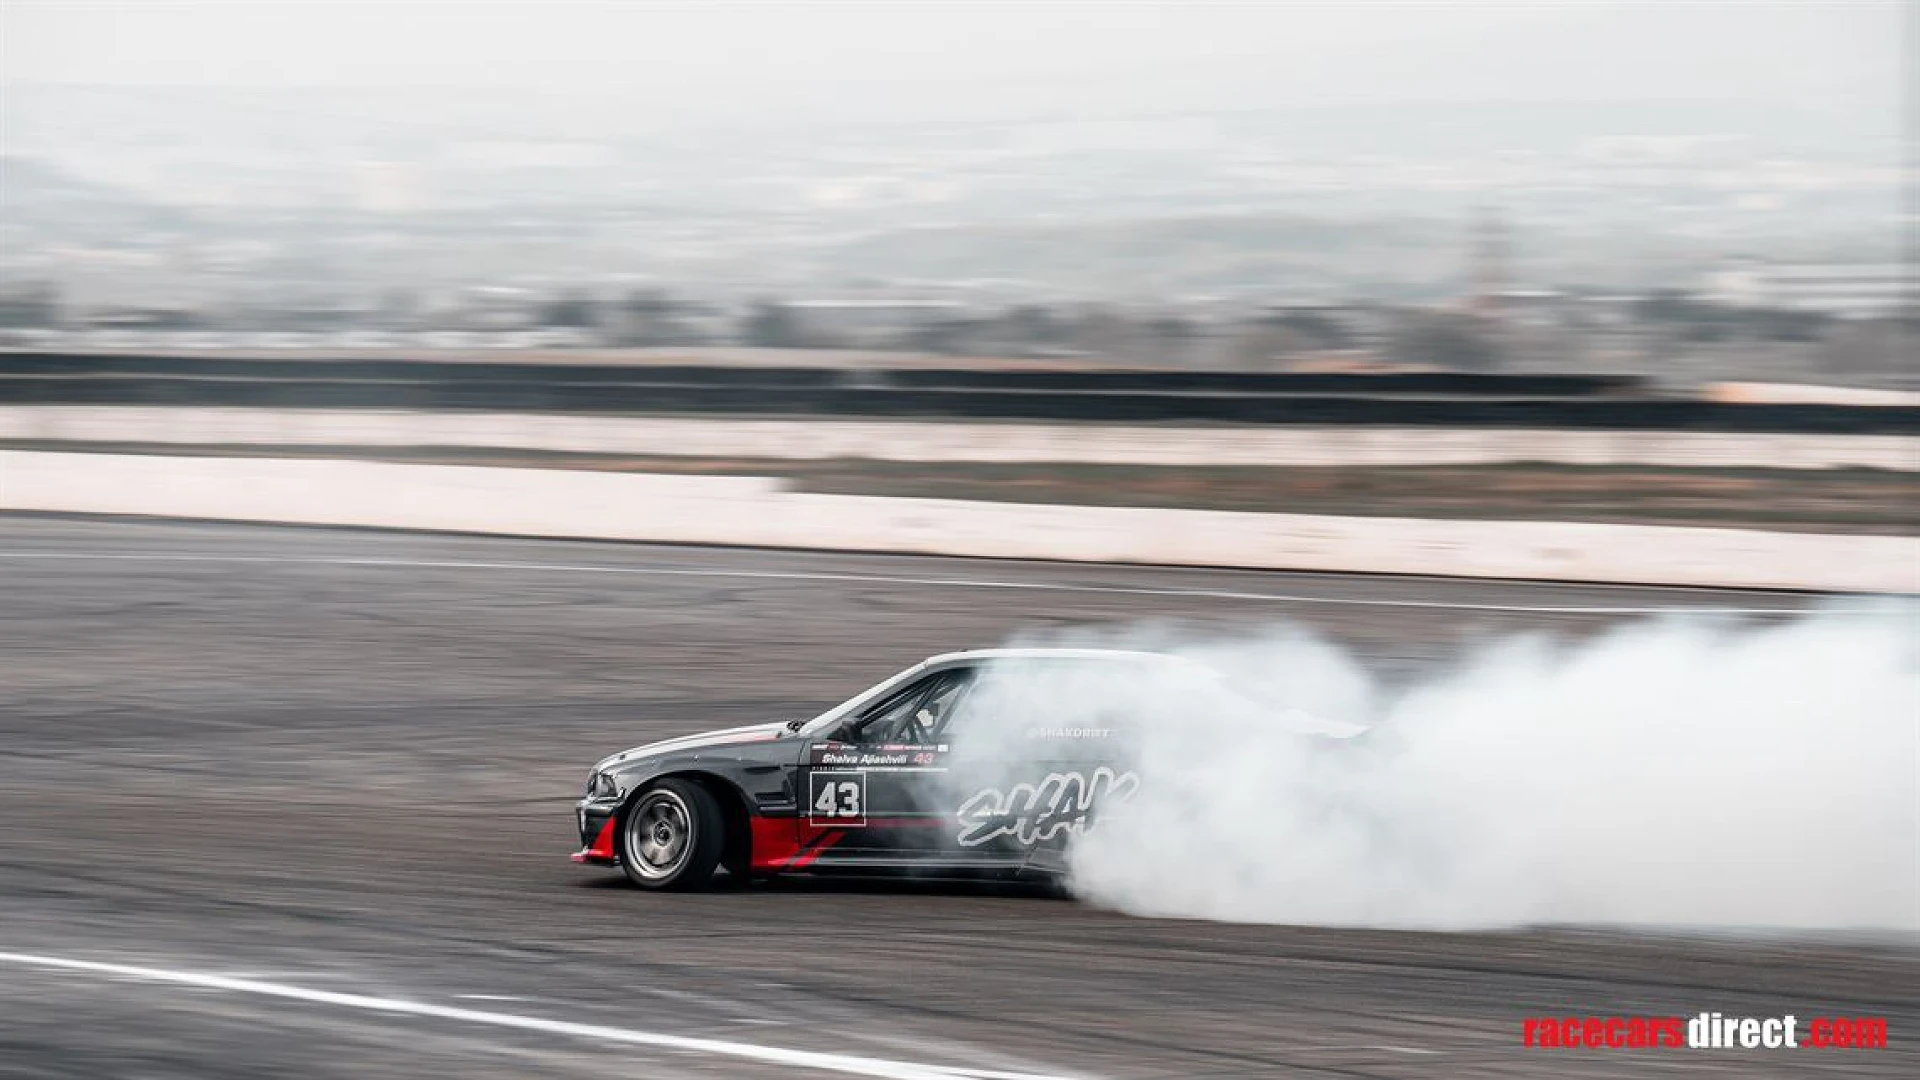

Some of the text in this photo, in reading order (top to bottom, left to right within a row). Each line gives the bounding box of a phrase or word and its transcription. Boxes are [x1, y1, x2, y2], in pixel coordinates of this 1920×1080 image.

[822, 753, 858, 764] Shalva
[914, 752, 934, 764] 43
[814, 781, 860, 817] 43
